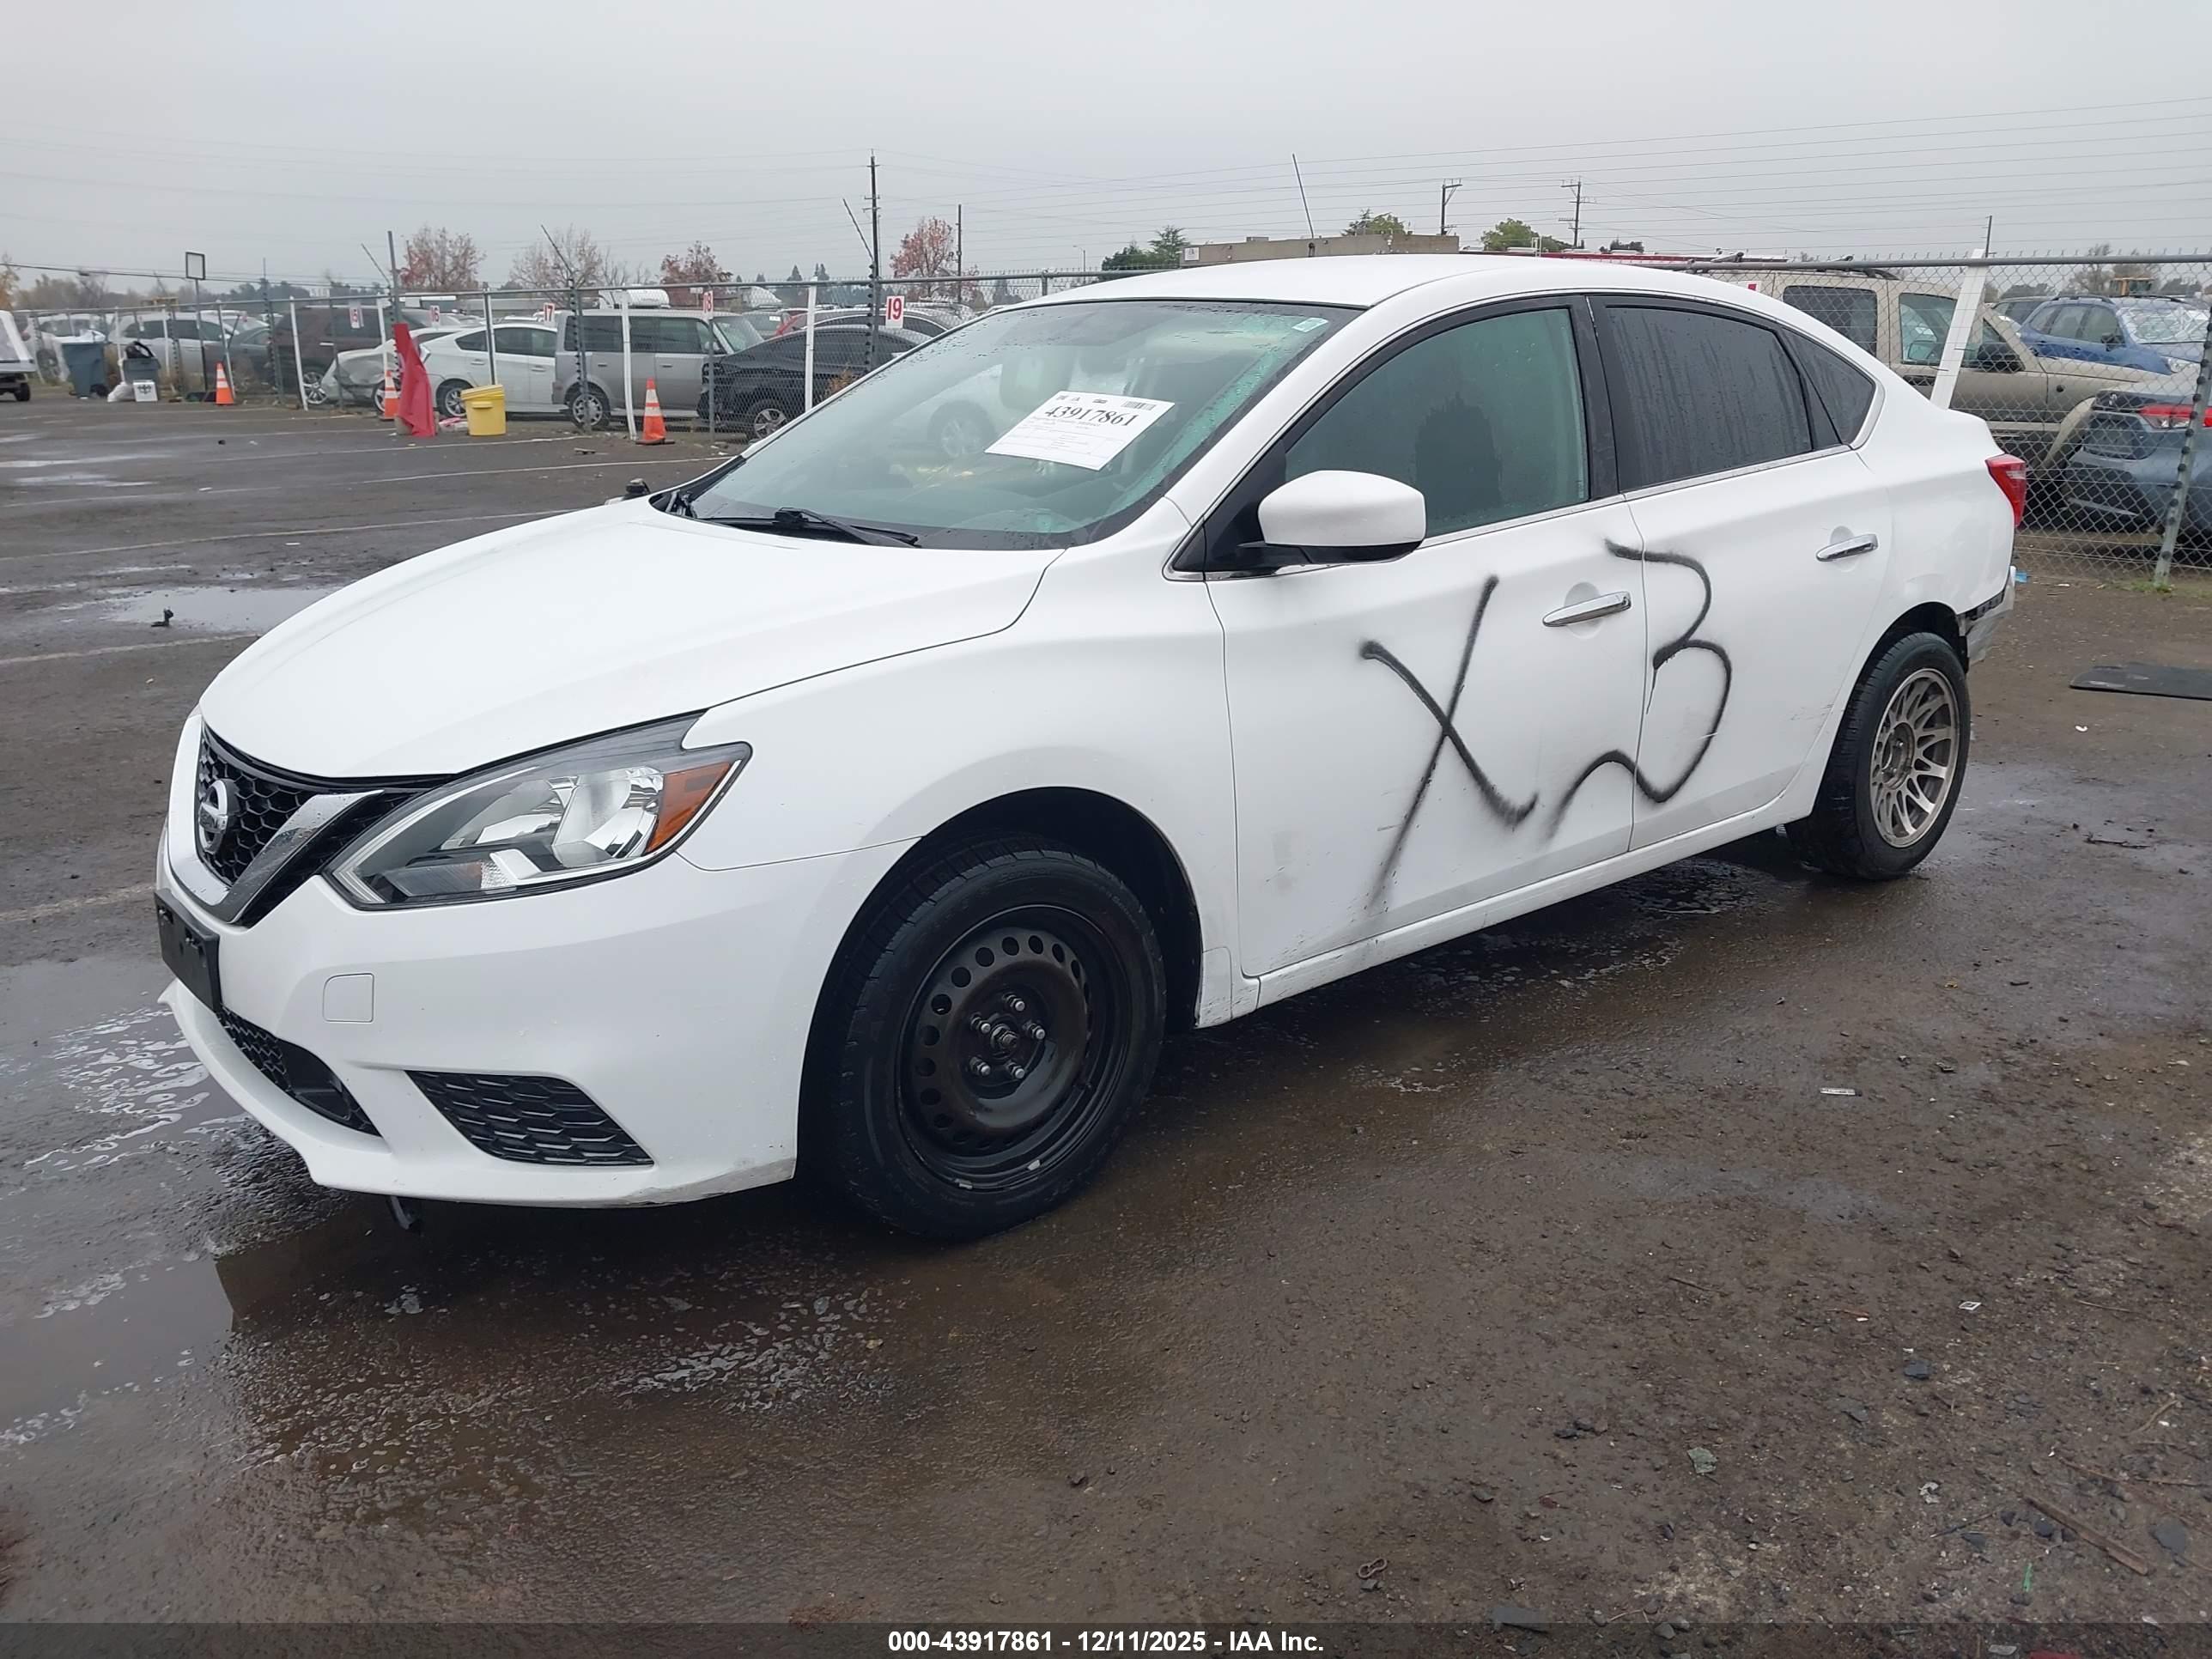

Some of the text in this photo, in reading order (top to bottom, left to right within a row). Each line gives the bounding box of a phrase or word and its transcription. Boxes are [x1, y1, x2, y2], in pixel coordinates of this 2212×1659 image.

[544, 304, 554, 321] 17
[888, 297, 902, 320] 19
[1044, 405, 1139, 426] 43917861
